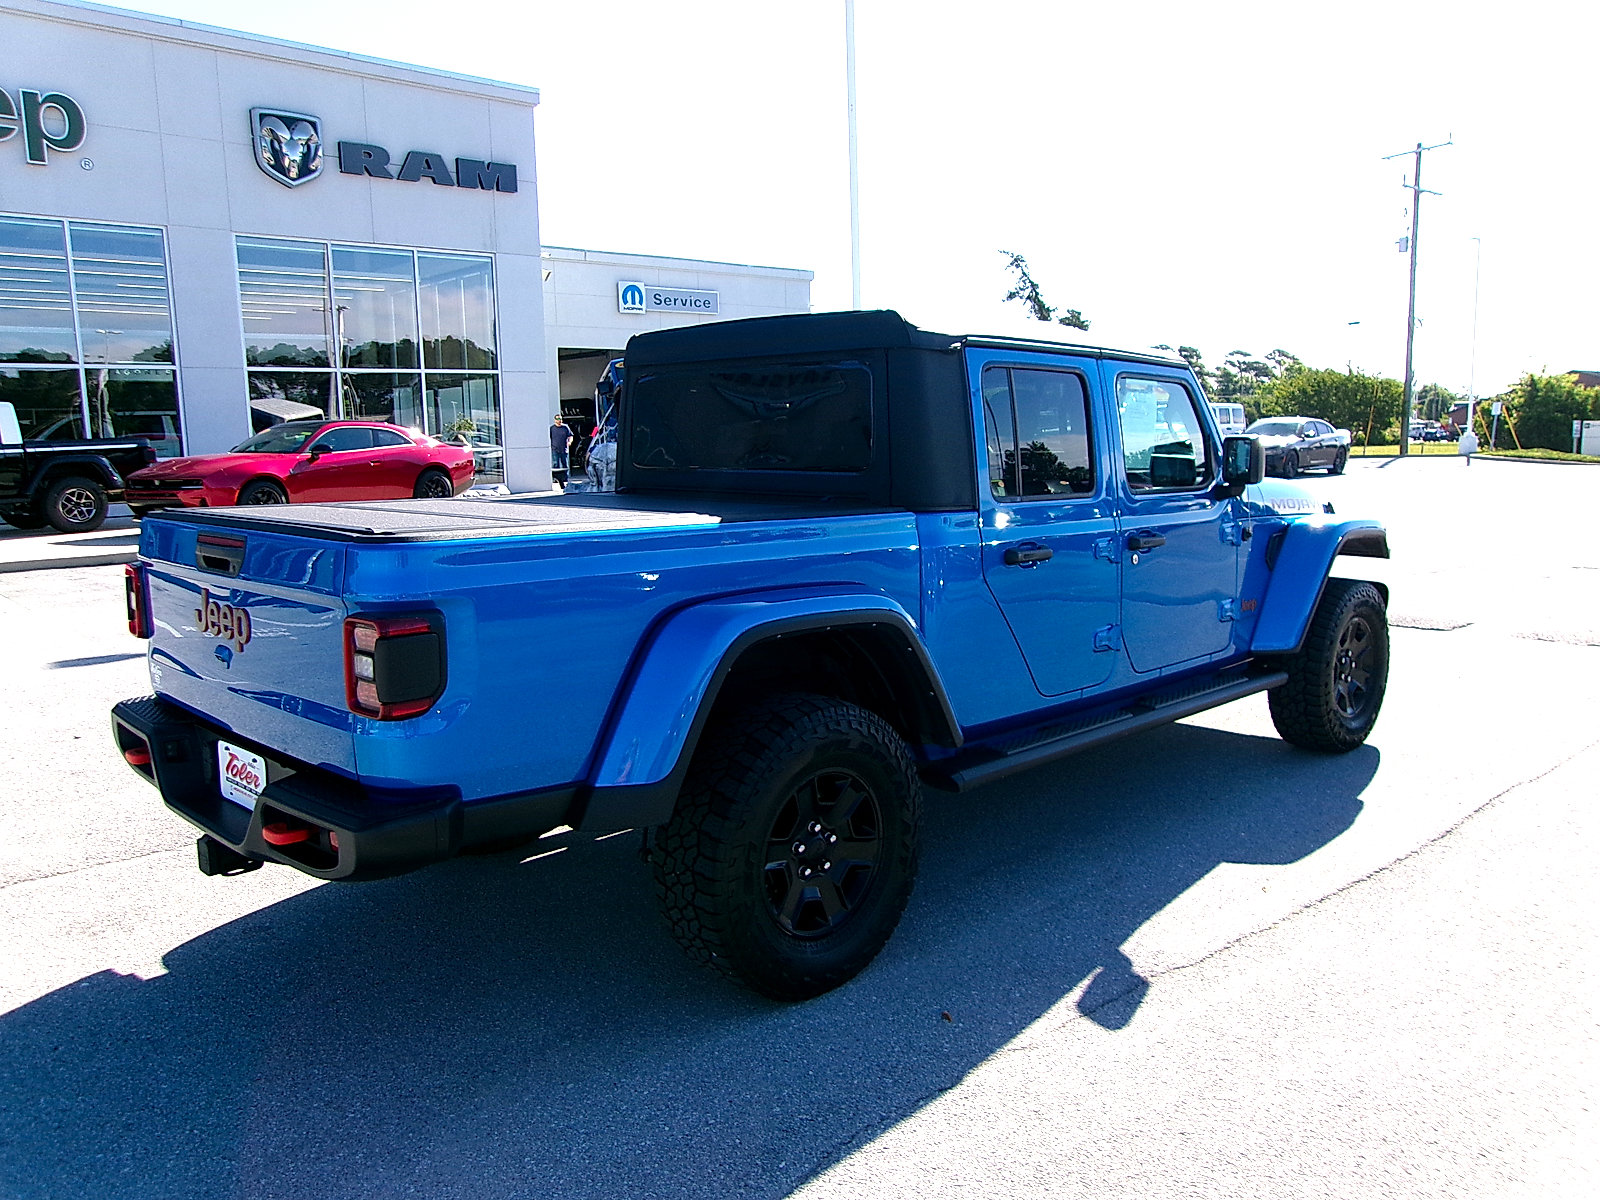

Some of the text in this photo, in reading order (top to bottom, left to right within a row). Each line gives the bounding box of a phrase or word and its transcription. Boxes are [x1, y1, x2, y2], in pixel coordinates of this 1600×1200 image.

[337, 141, 518, 193] RAM
[653, 293, 711, 308] Service
[1270, 499, 1320, 511] MOJAV
[195, 588, 251, 652] Jeep
[226, 752, 261, 789] Toler
